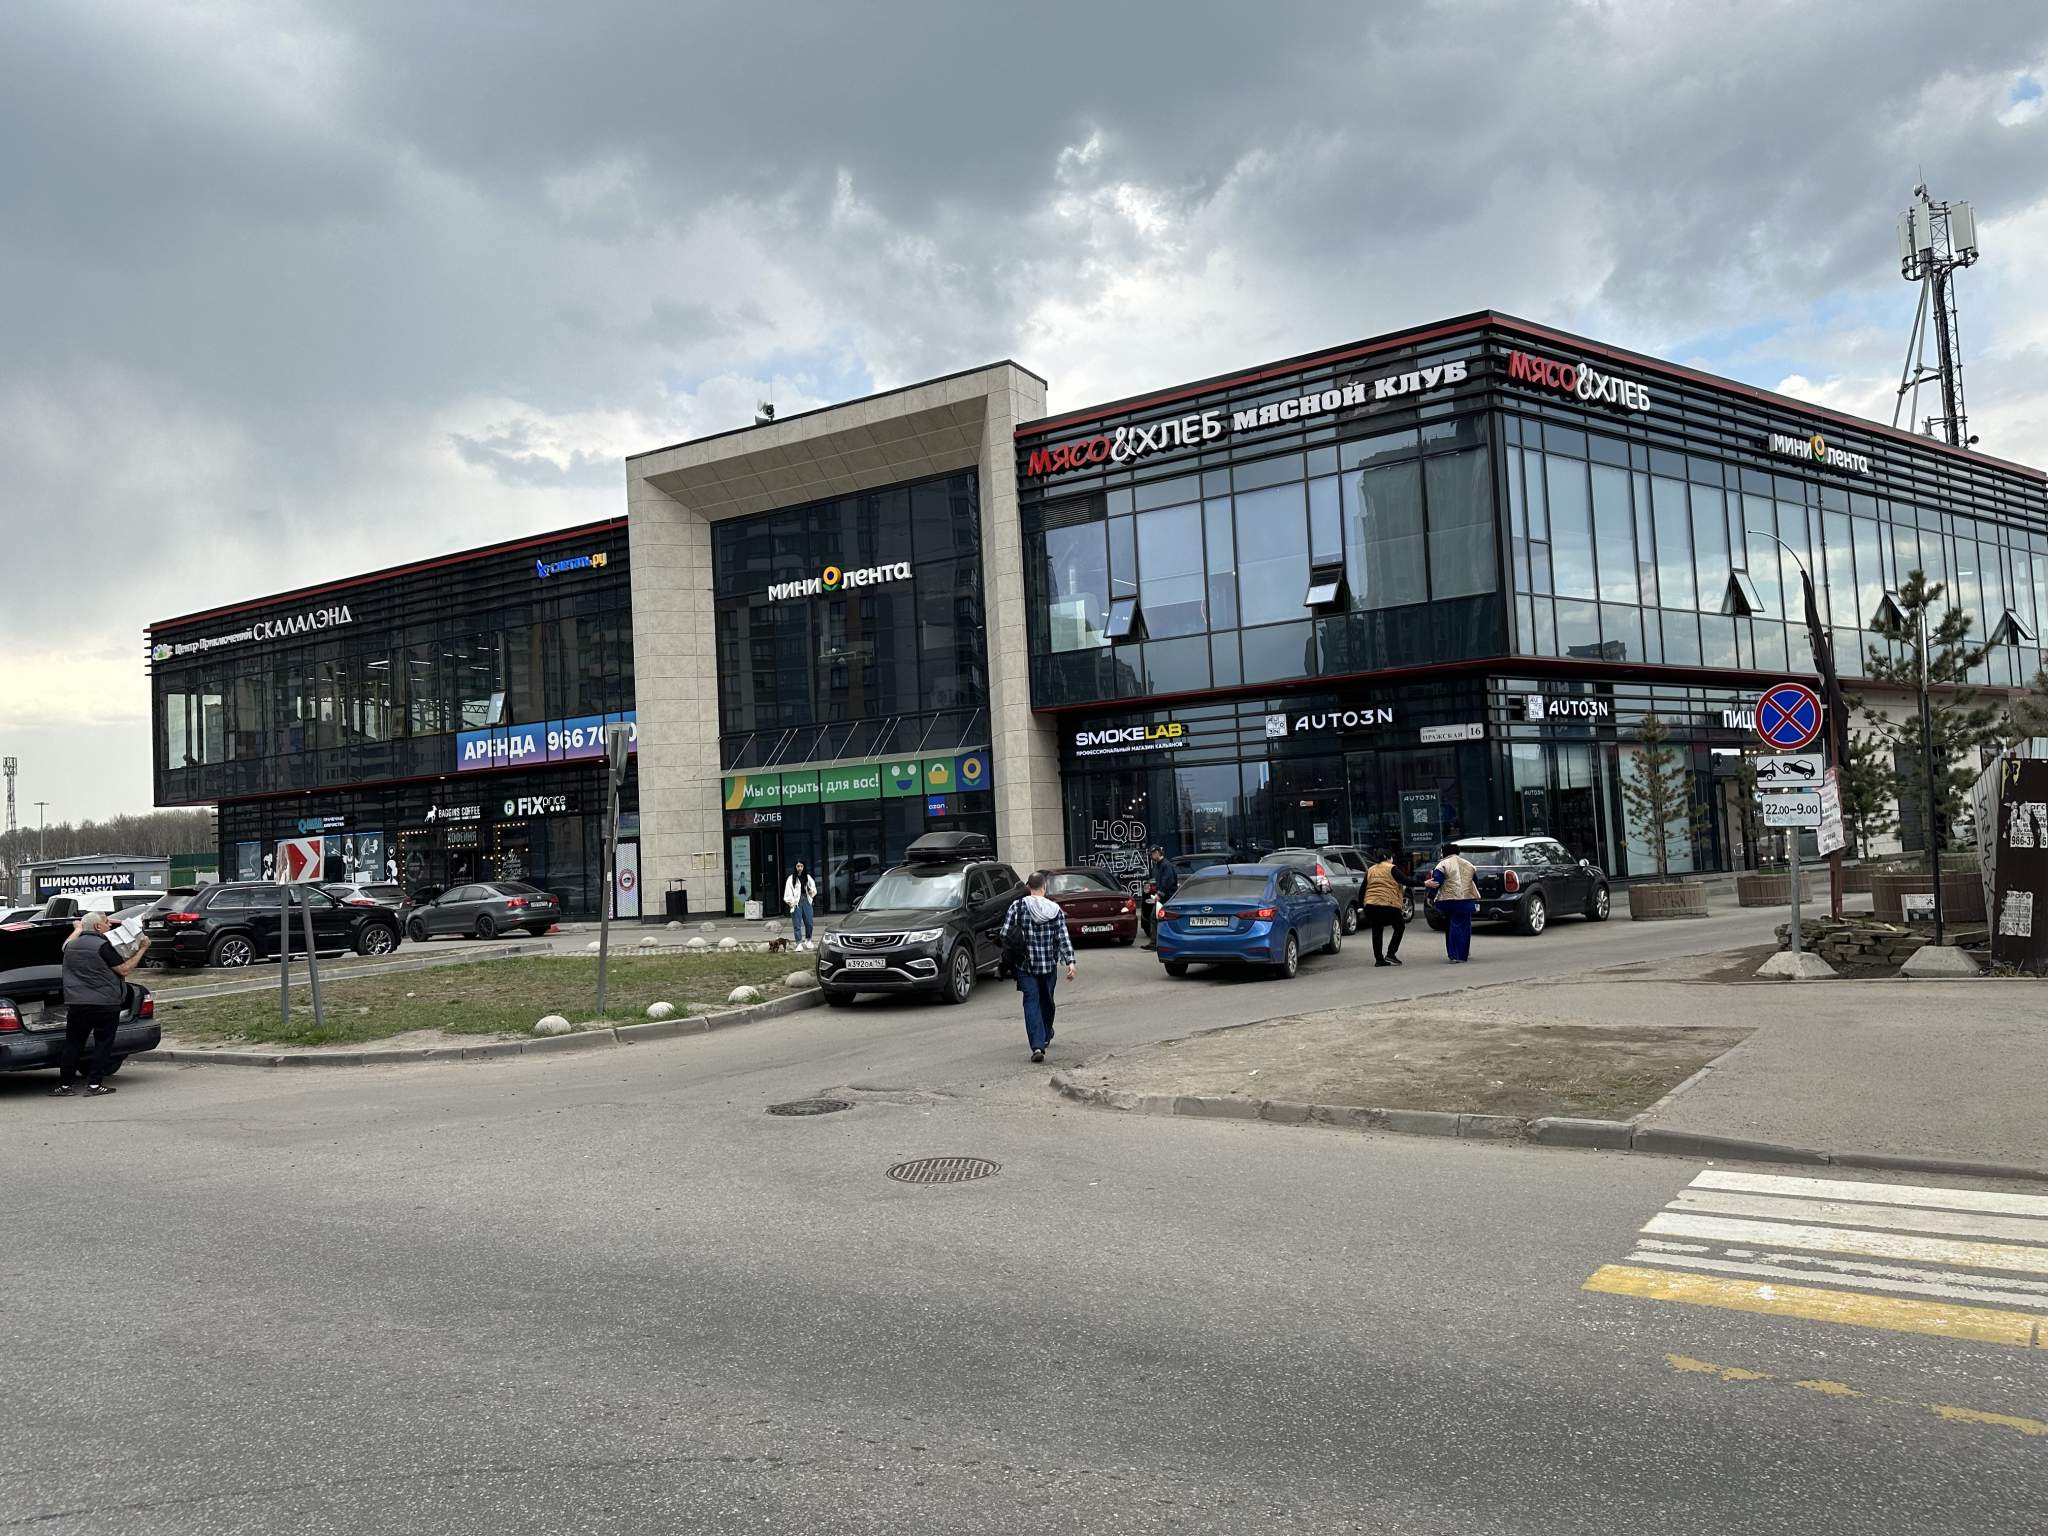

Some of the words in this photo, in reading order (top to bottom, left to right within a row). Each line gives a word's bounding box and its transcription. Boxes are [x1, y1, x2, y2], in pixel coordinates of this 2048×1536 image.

[1233, 380, 1366, 431] МЯСНОЙ
[1374, 360, 1468, 399] КЛУБ
[1826, 447, 1868, 473] лента
[841, 561, 912, 589] лента
[253, 605, 353, 641] СКАЛАЛЭНД
[1295, 708, 1393, 731] AUTO3N
[1548, 700, 1608, 716] AUTO3N
[1076, 723, 1183, 746] SMOKELAB
[1470, 727, 1481, 736] 16
[464, 734, 536, 761] АРЕНДА
[547, 728, 584, 751] 966
[1131, 743, 1155, 752] МАГАЗИН
[743, 786, 764, 798] Мы
[767, 782, 823, 798] открыты
[826, 779, 850, 793] для
[853, 773, 879, 789] вас!
[461, 805, 481, 816] COFFEE
[1091, 819, 1147, 843] HQD
[40, 874, 130, 887] ШИНОМОНТАЖ
